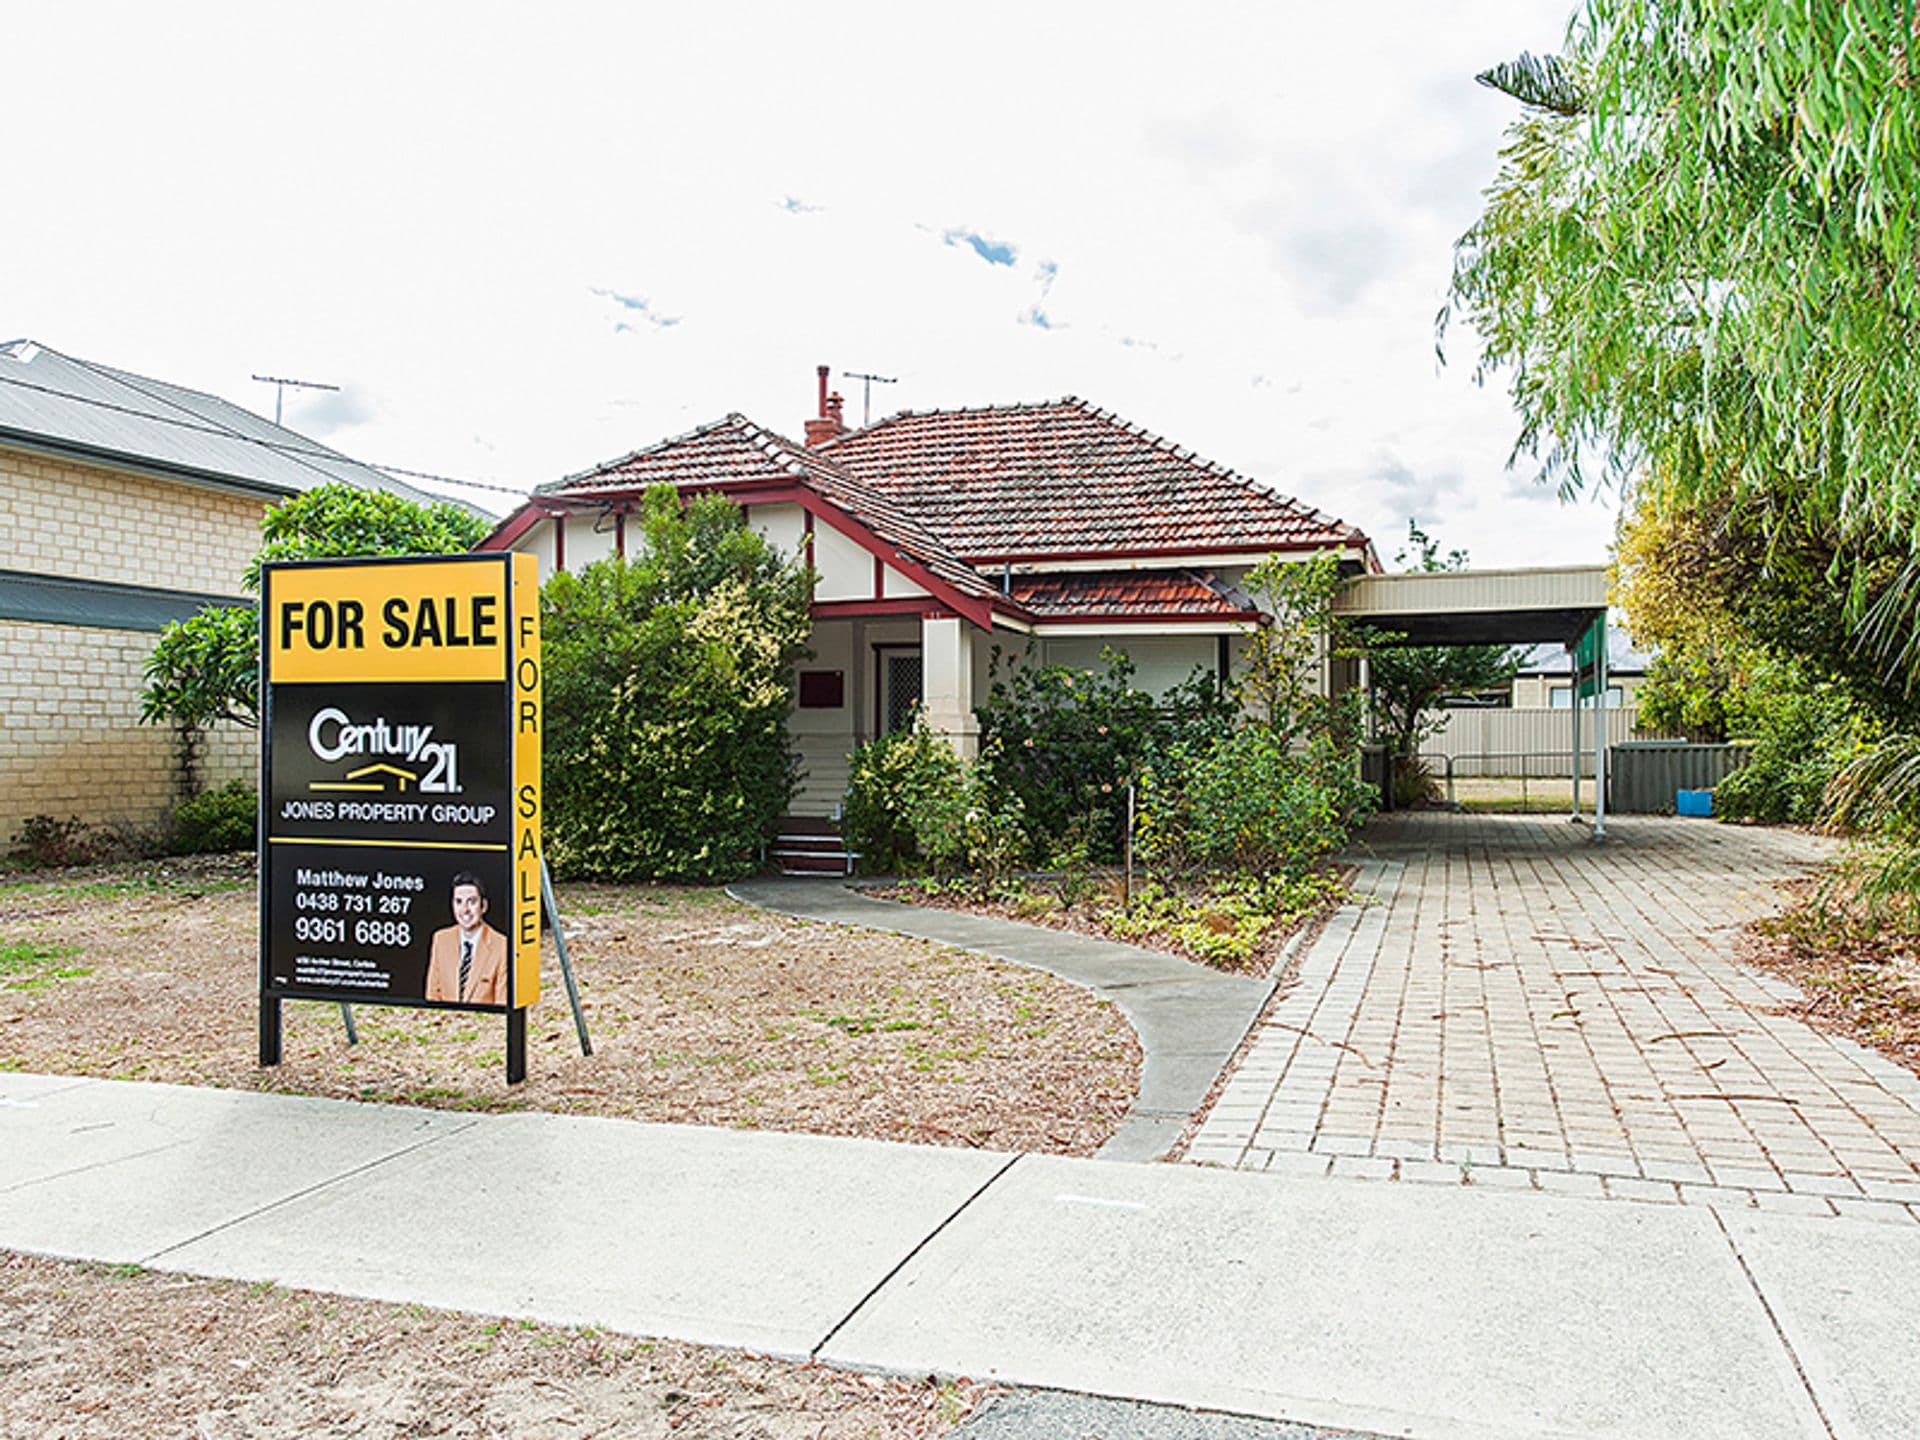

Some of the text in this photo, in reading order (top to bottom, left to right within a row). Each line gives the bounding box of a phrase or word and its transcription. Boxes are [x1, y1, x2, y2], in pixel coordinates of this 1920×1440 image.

[281, 595, 498, 650] FOR SALE
[308, 707, 434, 762] Century
[518, 617, 539, 945] FOR SALE
[281, 801, 496, 824] JONES PROPERTY GROUP
[296, 868, 424, 891] Matthew Jones
[296, 892, 411, 914] 0438 731 267
[295, 917, 411, 947] 9361 6888
